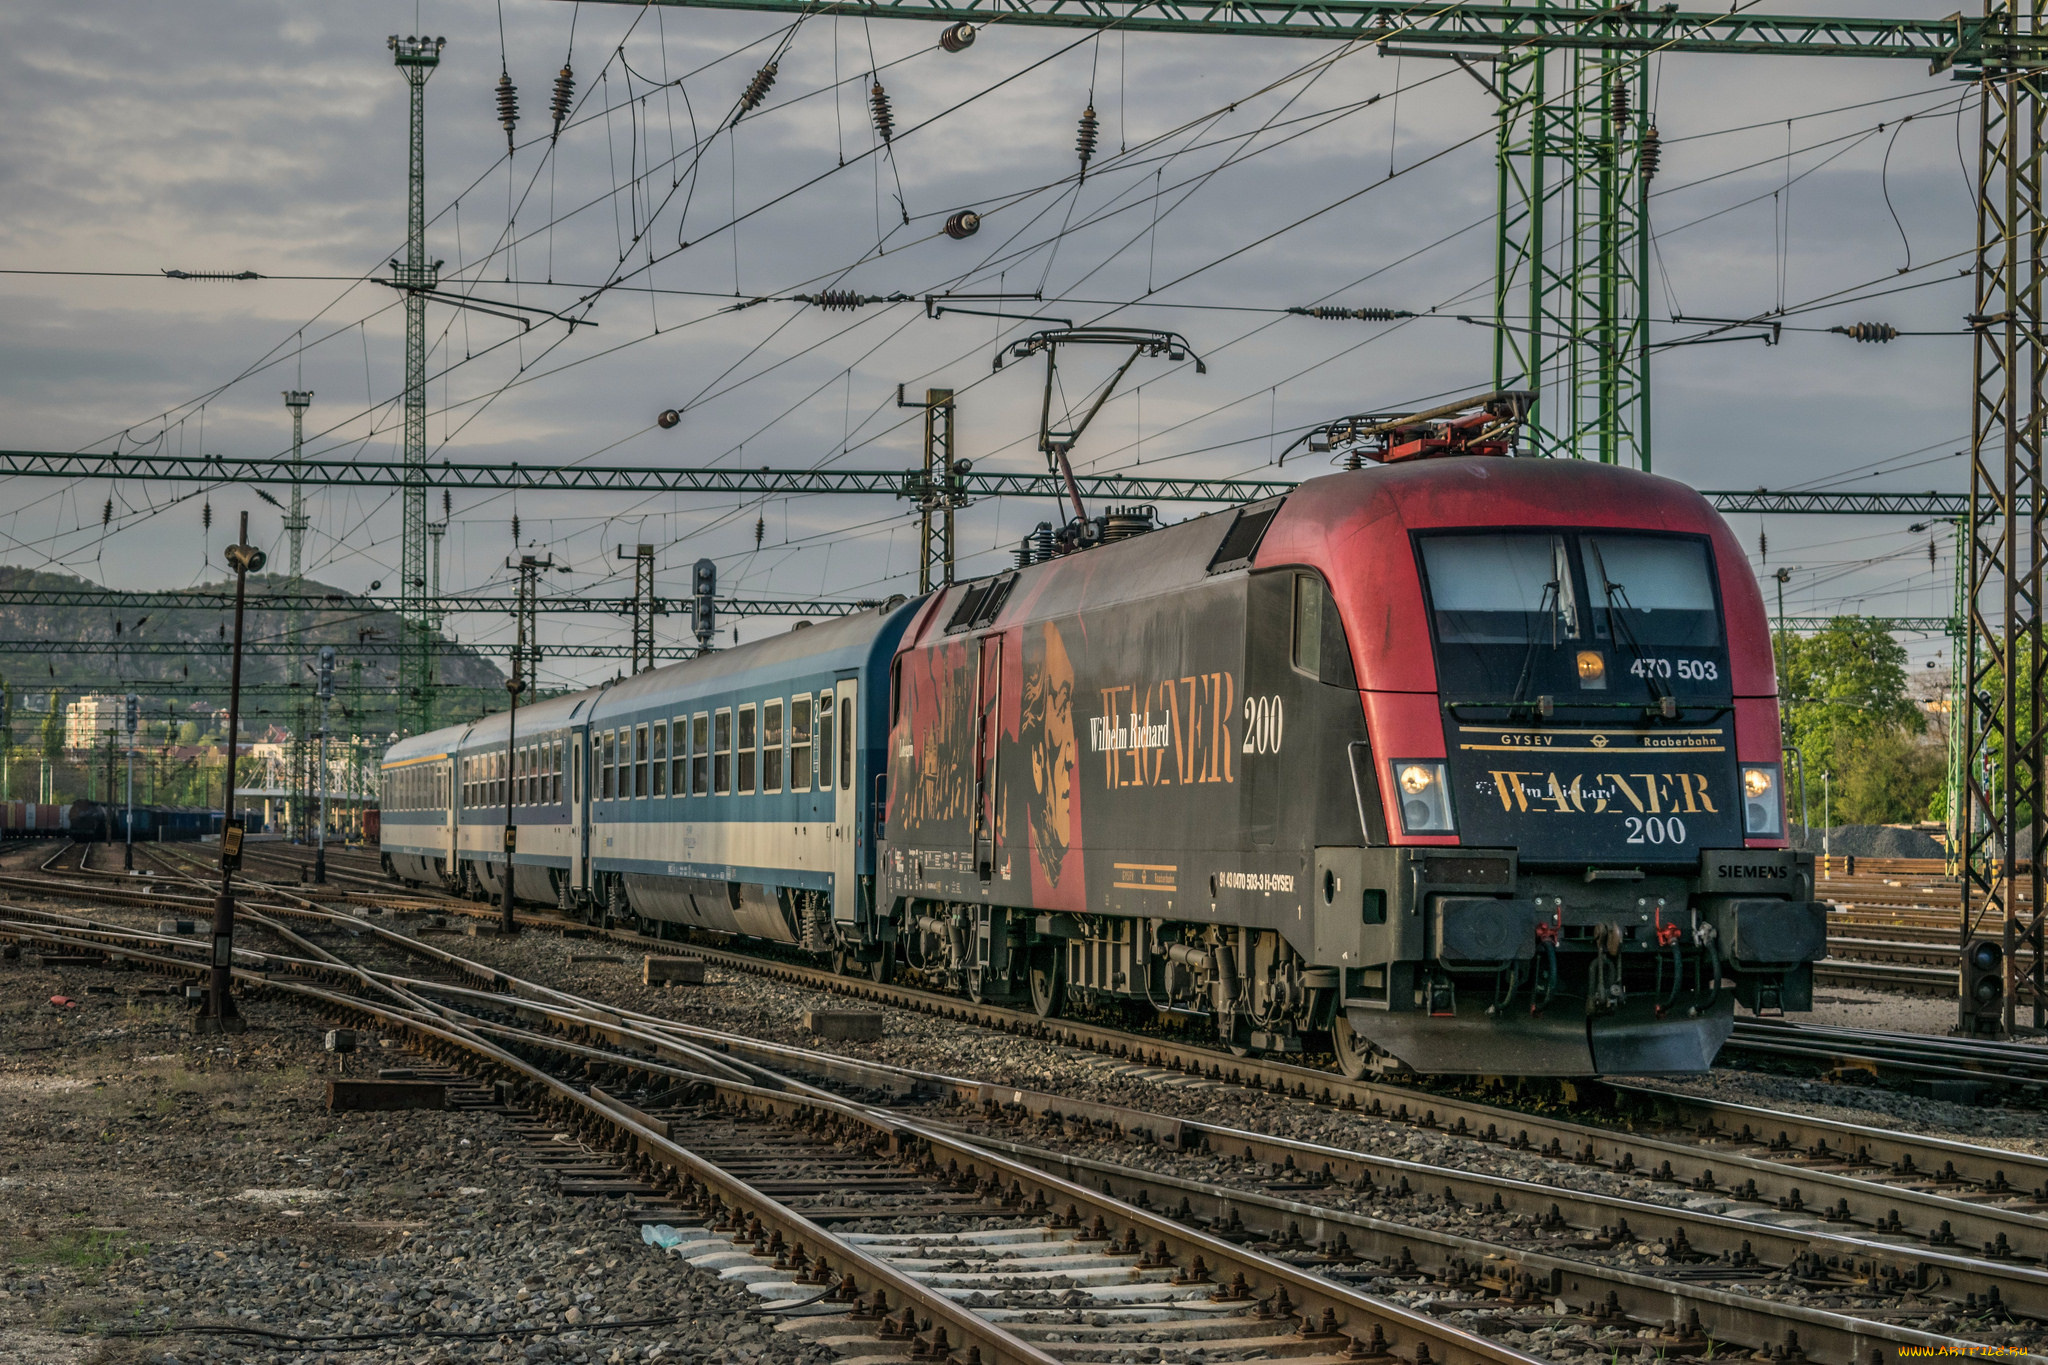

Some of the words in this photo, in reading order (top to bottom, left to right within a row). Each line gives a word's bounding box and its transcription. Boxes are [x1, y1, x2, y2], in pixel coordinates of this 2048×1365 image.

[1630, 658, 1671, 678] 470
[1677, 660, 1718, 680] 503
[1090, 715, 1127, 752] Wilhelm
[1129, 710, 1169, 749] Richard
[1101, 672, 1233, 789] WAGNER
[1243, 695, 1283, 755] 200
[1501, 734, 1553, 746] GYSEV
[1644, 736, 1717, 747] Raaberbahn
[1488, 770, 1719, 813] WAGNER
[1625, 816, 1686, 844] 200
[1264, 874, 1294, 893] H-GYSEV
[1718, 865, 1788, 879] SIEMENS
